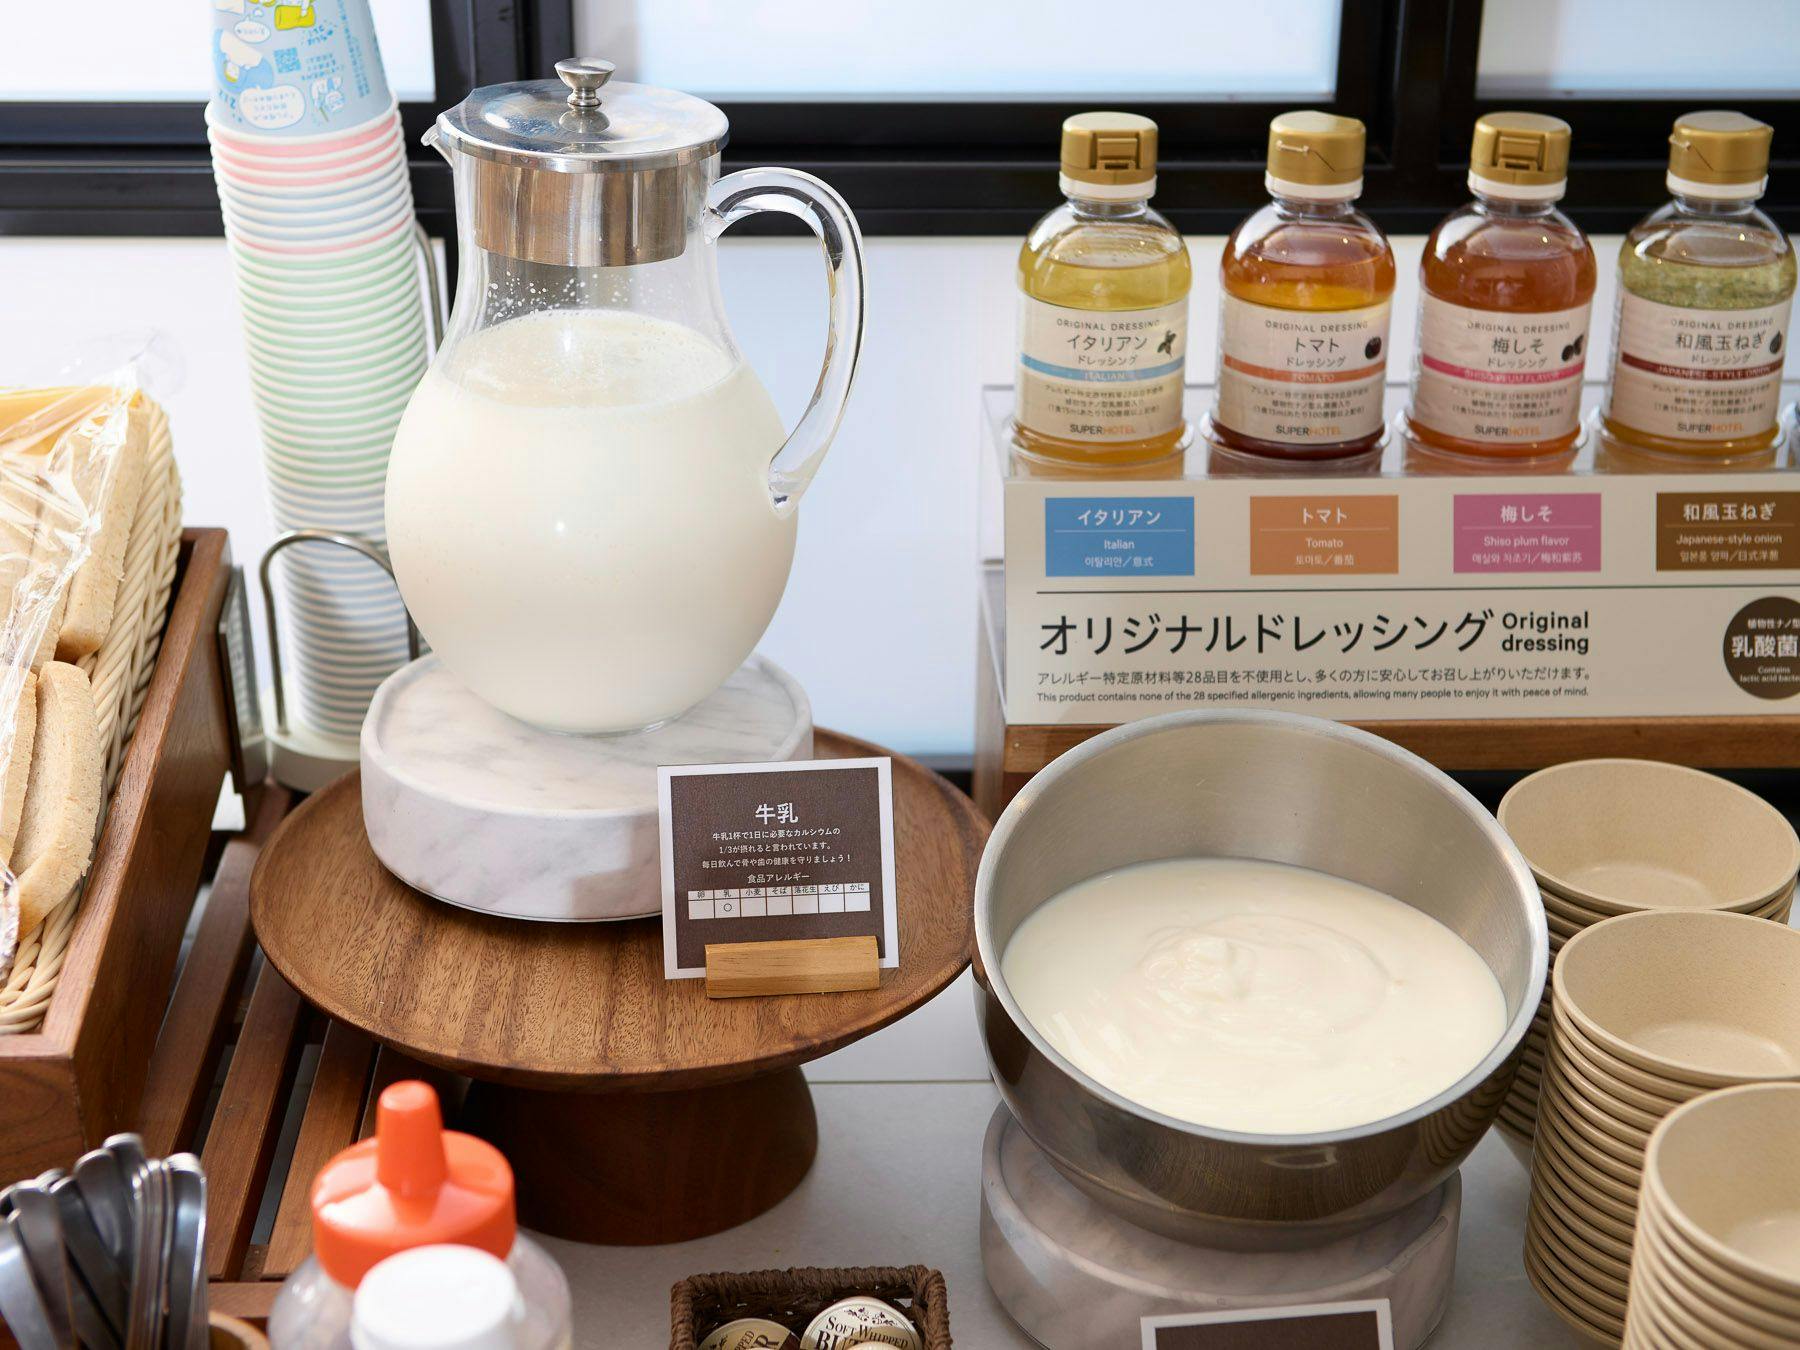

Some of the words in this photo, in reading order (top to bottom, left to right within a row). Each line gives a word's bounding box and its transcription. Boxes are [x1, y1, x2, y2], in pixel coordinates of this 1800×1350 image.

[1056, 318, 1106, 331] ORIGINAL
[1111, 319, 1160, 331] DRESSING
[1265, 320, 1316, 332] ORIGINAL
[1320, 320, 1369, 332] DRESSING
[1467, 321, 1518, 334] ORIGINAL
[1522, 322, 1571, 334] DRESSING
[1671, 319, 1721, 329] ORIGINAL
[1727, 318, 1774, 329] DRESSING
[1067, 335, 1148, 352] イタリアン
[1295, 337, 1340, 353] トマト
[1492, 338, 1544, 355] 梅しそ
[1675, 330, 1766, 351] 和風玉ねぎ
[1077, 355, 1138, 367] ドレッシング
[1286, 356, 1346, 368] ドレッシング
[1487, 357, 1548, 369] ドレッシング
[1691, 353, 1752, 366] ドレッシング
[1085, 371, 1126, 380] ITALIAN
[1294, 373, 1335, 383] TOMATO
[1077, 508, 1161, 526] イタリアン
[1302, 507, 1348, 525] トマト
[1500, 504, 1553, 523] 梅しそ
[1683, 502, 1776, 521] 和風玉ねぎ
[1103, 539, 1135, 550] Italian
[1306, 537, 1344, 548] Tomato
[1483, 535, 1511, 547] Shiso
[1513, 535, 1539, 548] plum
[1541, 535, 1570, 546] flavor
[1675, 533, 1752, 546] Japanese-style
[1754, 533, 1783, 544] onion
[1502, 612, 1589, 633] Original
[1039, 608, 1494, 656] オリジナルドレッシング
[1501, 634, 1590, 655] dressing
[1731, 635, 1800, 658] 乳酸菌
[1037, 667, 1590, 686] アレルギー特定原材料等28品目を不使用とし、多くの方に安心してお召し上がりいただけます。
[1758, 665, 1791, 675] Contains
[1037, 693, 1057, 701] This
[1059, 692, 1095, 703] product
[1097, 692, 1136, 701] contains
[1139, 693, 1163, 701] none
[1164, 691, 1174, 700] of
[1176, 691, 1191, 700] the
[1193, 691, 1205, 700] 28
[1207, 690, 1249, 702] specified
[1251, 690, 1295, 701] allergenic
[1298, 690, 1351, 701] ingredients,
[1353, 689, 1391, 700] allowing
[1393, 689, 1418, 698] many
[1420, 688, 1451, 699] people
[1453, 688, 1463, 697] to
[1465, 687, 1490, 699] enjoy
[1492, 687, 1498, 696] it
[1501, 687, 1520, 696] with
[1523, 688, 1550, 698] peace
[1552, 686, 1562, 696] of
[1564, 686, 1589, 696] mind.
[755, 802, 799, 825] 牛乳
[712, 827, 841, 841] 牛乳1杯で1日に必要なカルシウムの
[718, 841, 831, 854] 1/3が摂れると言われています。
[747, 872, 810, 884] 食品アレルギー
[723, 889, 731, 898] 乳
[745, 888, 762, 897] 小麦
[771, 887, 787, 895] そば
[793, 885, 817, 895] 落花生
[824, 884, 839, 892] えび
[849, 883, 865, 891] かに
[825, 1316, 858, 1336] SOFT
[859, 1324, 909, 1349] WHIPPED
